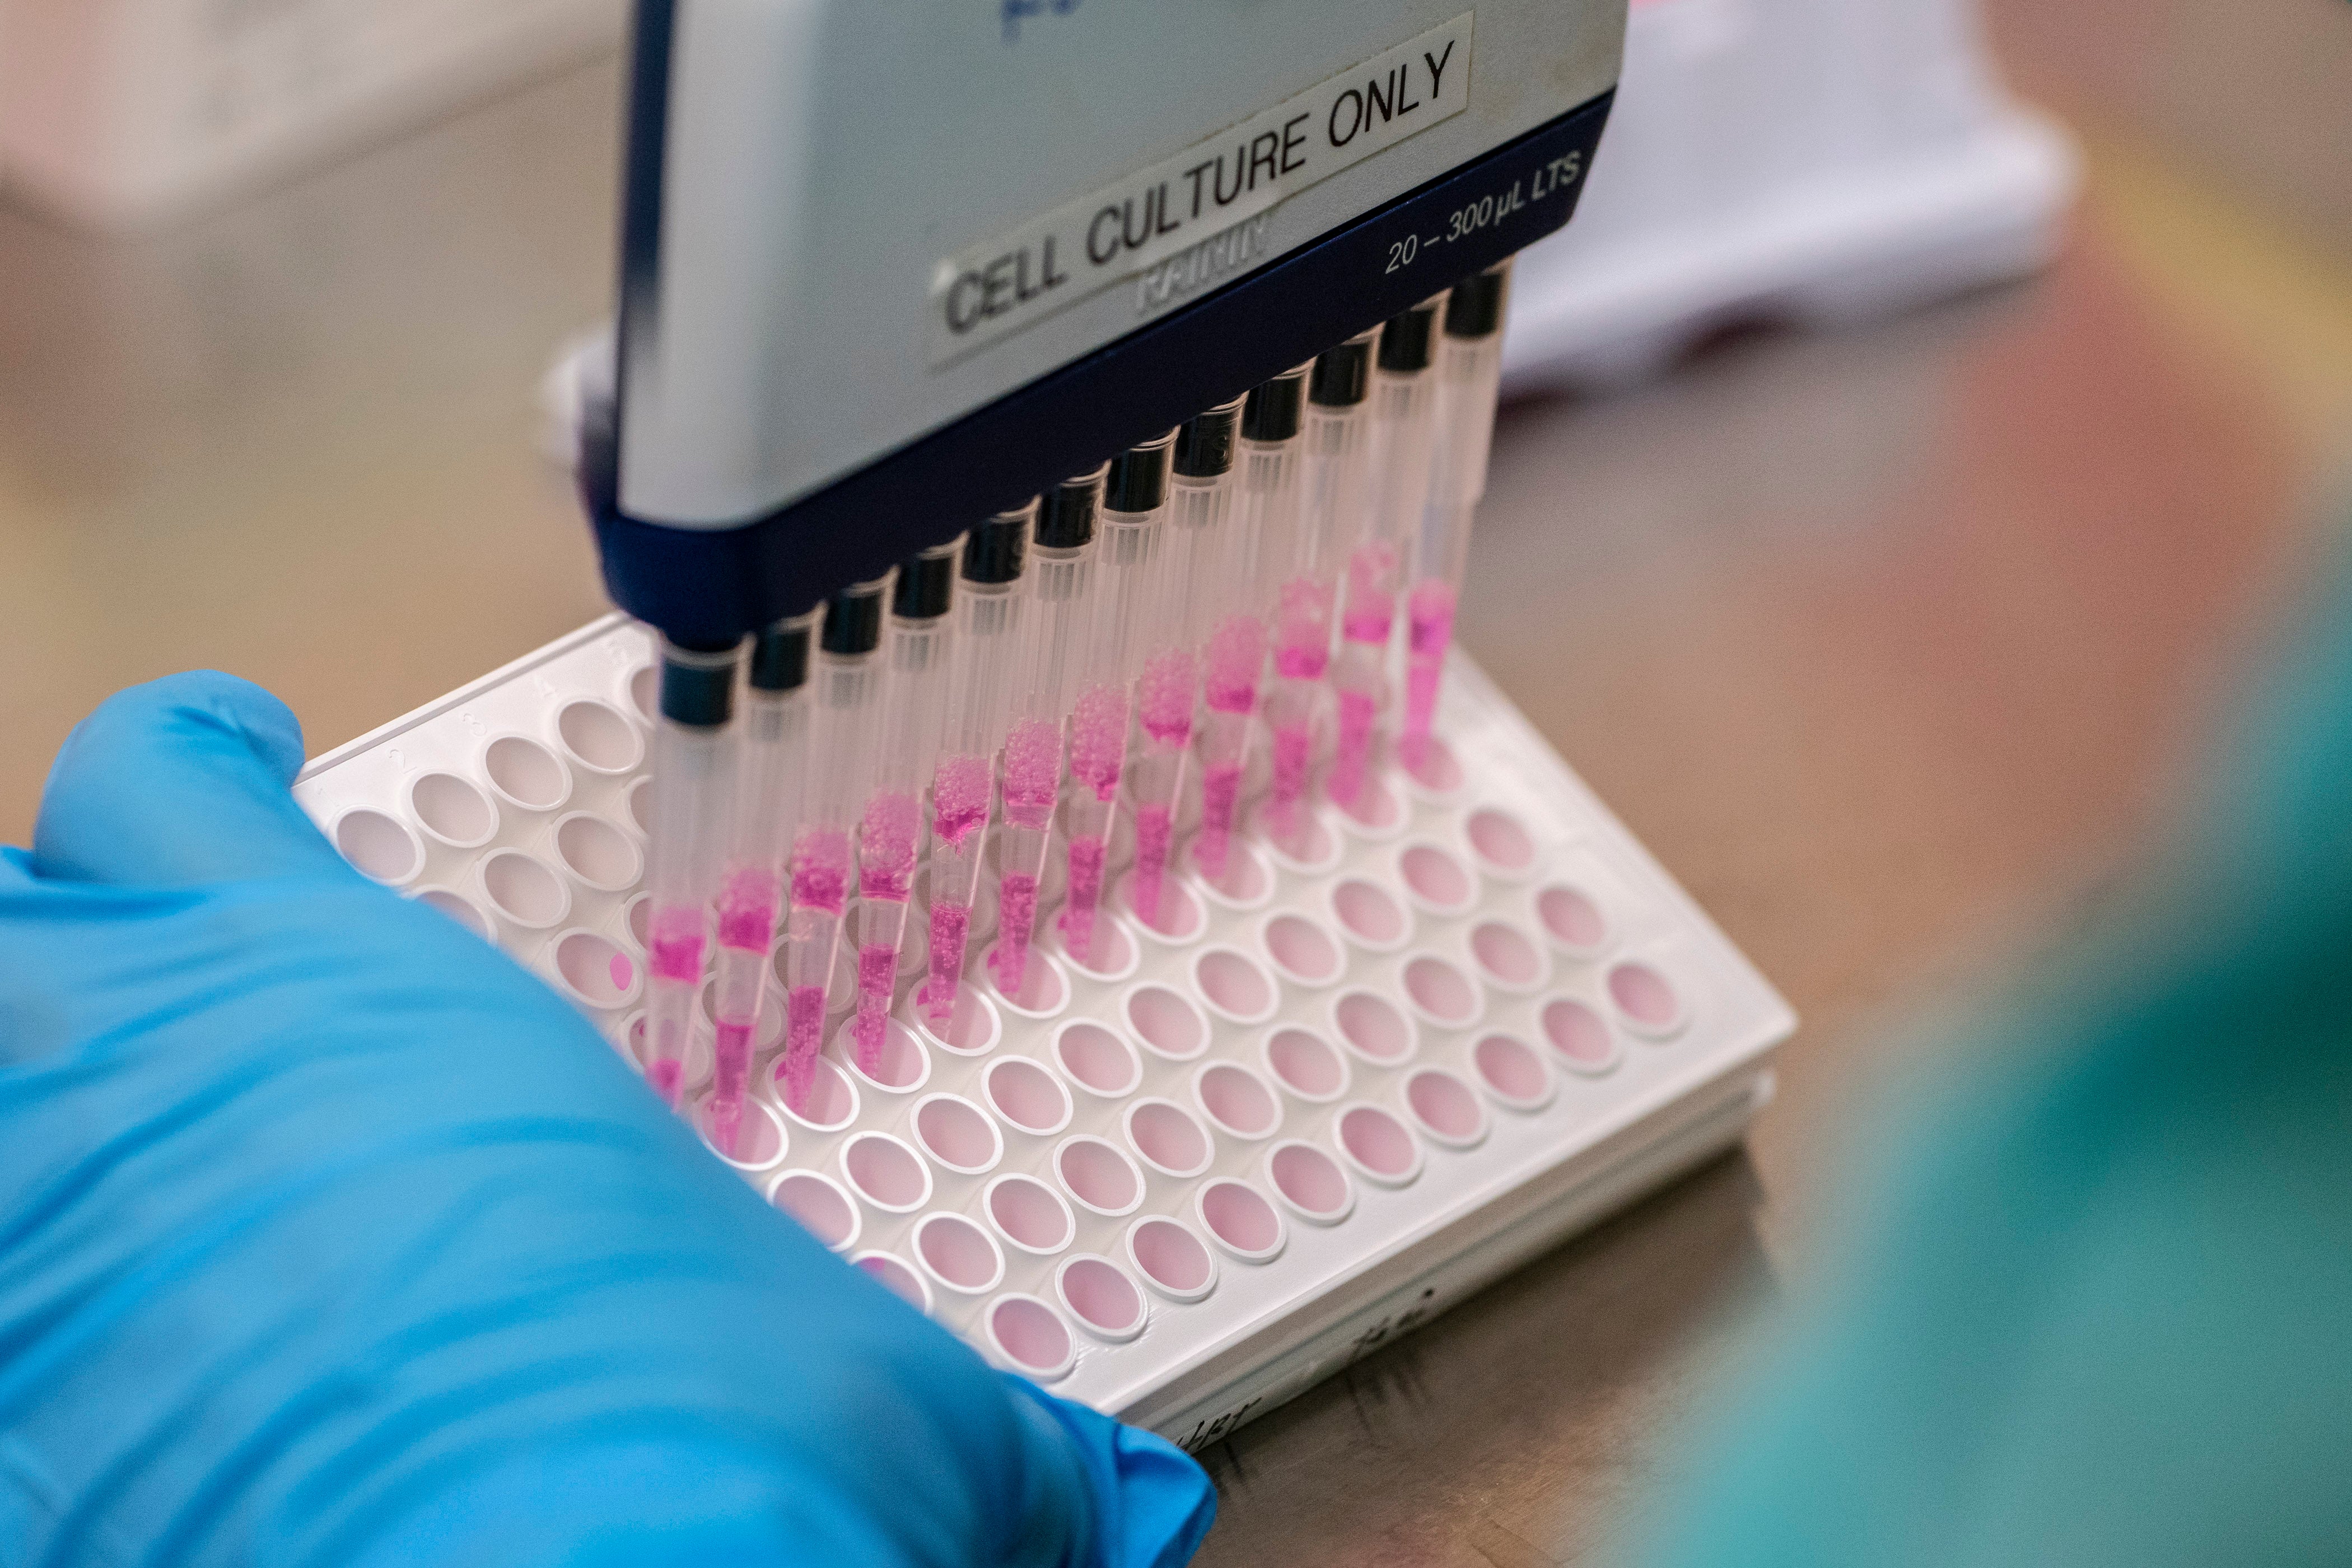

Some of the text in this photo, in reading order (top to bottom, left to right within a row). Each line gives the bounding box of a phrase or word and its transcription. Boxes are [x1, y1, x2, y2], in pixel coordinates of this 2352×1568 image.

[946, 40, 1455, 333] CELL CULTURE ONLY
[1385, 234, 1417, 274] 20
[1531, 150, 1581, 201] LTS
